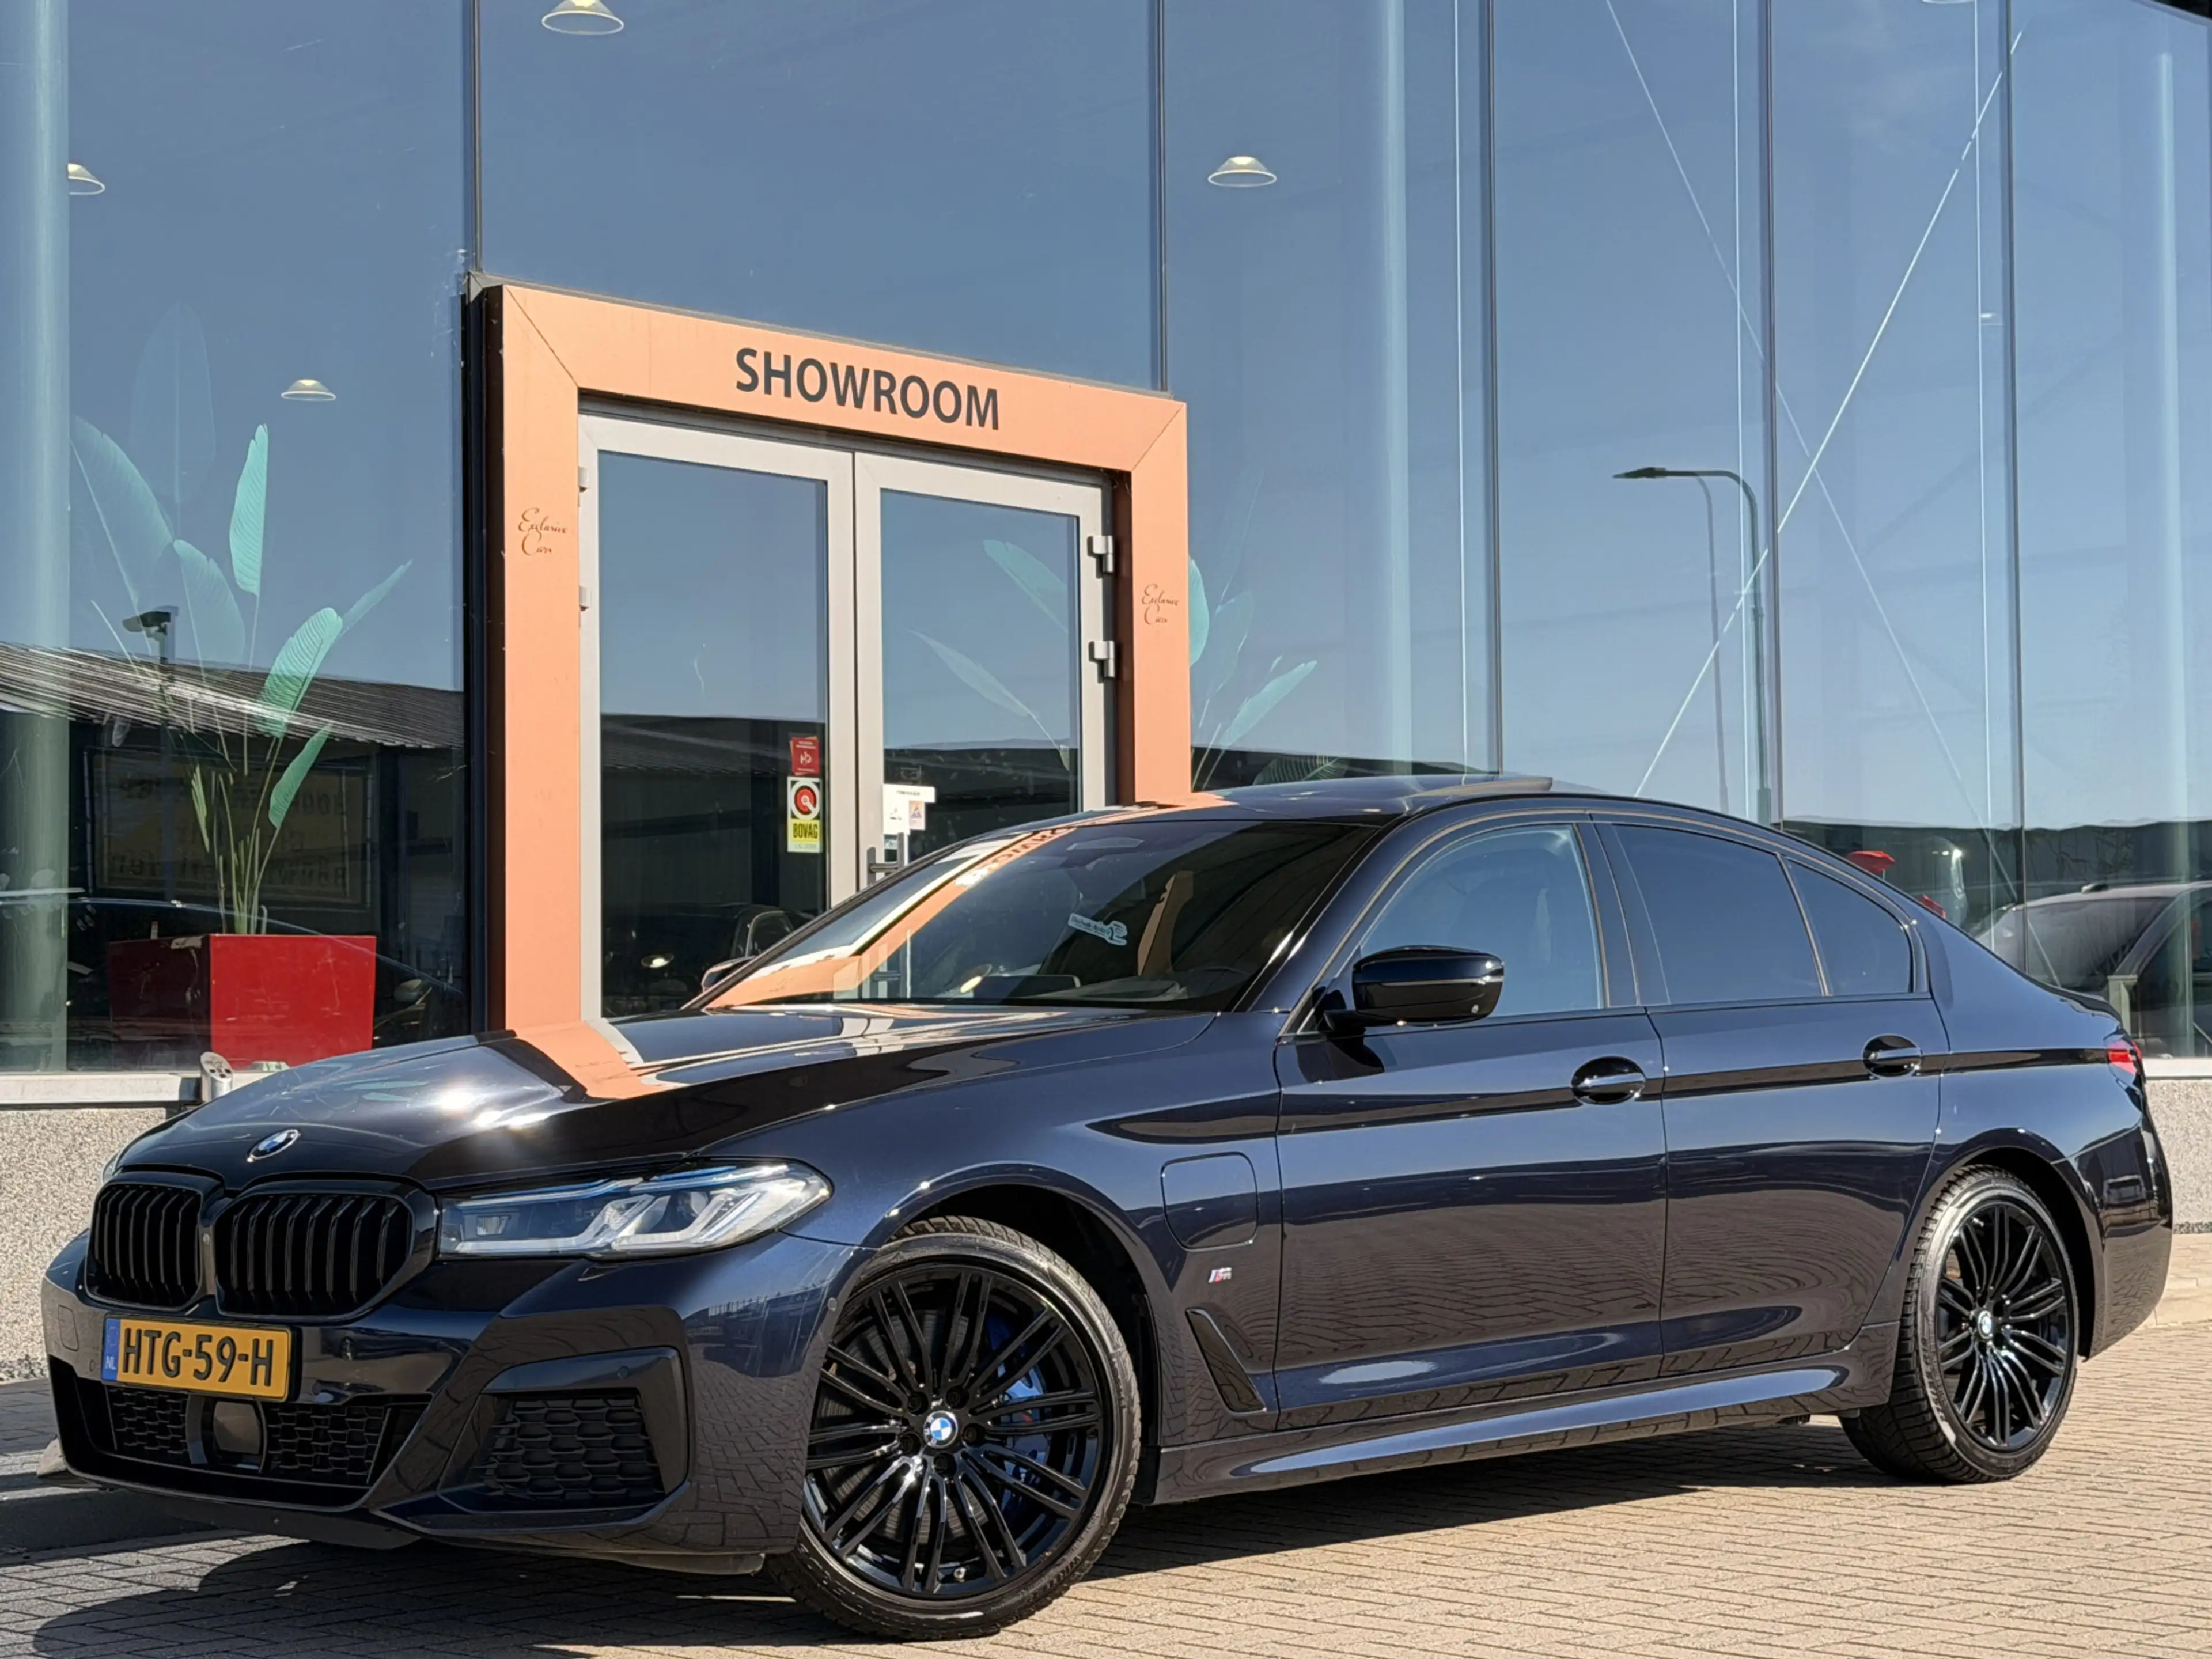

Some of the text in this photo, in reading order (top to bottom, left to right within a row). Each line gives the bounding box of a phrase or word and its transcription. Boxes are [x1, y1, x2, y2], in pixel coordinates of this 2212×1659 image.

[736, 347, 999, 430] SHOWROOM
[793, 823, 818, 839] BOVAG
[105, 1355, 117, 1370] NL
[122, 1328, 274, 1386] HTG-59-H
